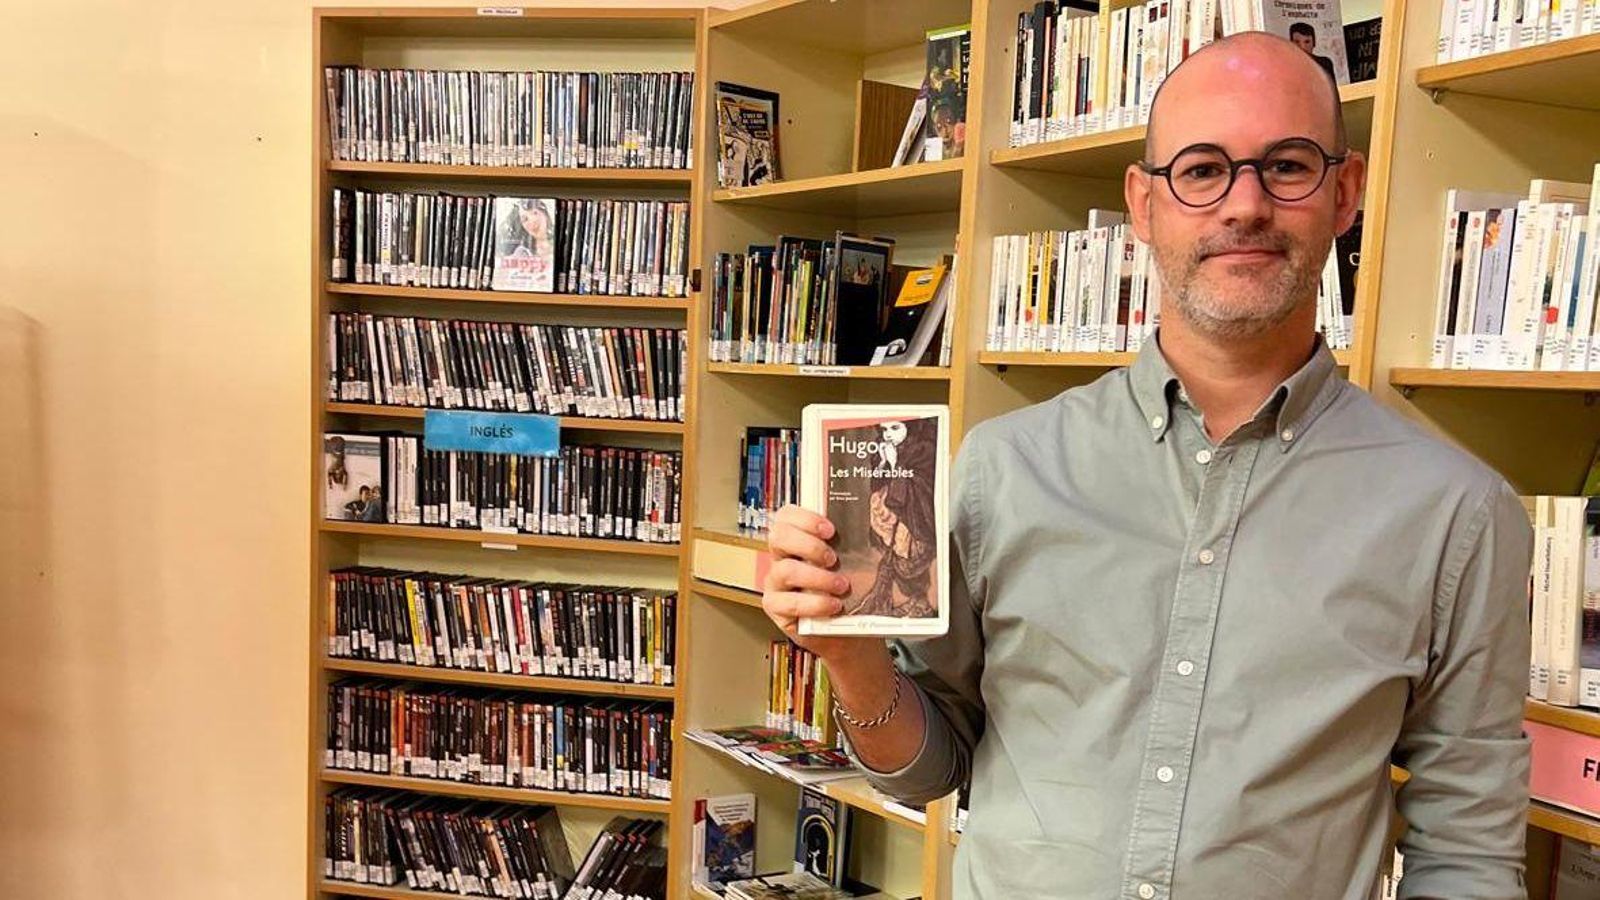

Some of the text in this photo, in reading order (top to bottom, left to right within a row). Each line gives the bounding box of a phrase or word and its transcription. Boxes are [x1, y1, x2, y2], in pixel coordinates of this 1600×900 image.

[470, 423, 513, 438] INGLÉS
[829, 436, 879, 458] Hugo
[829, 466, 914, 478] Les Misérables
